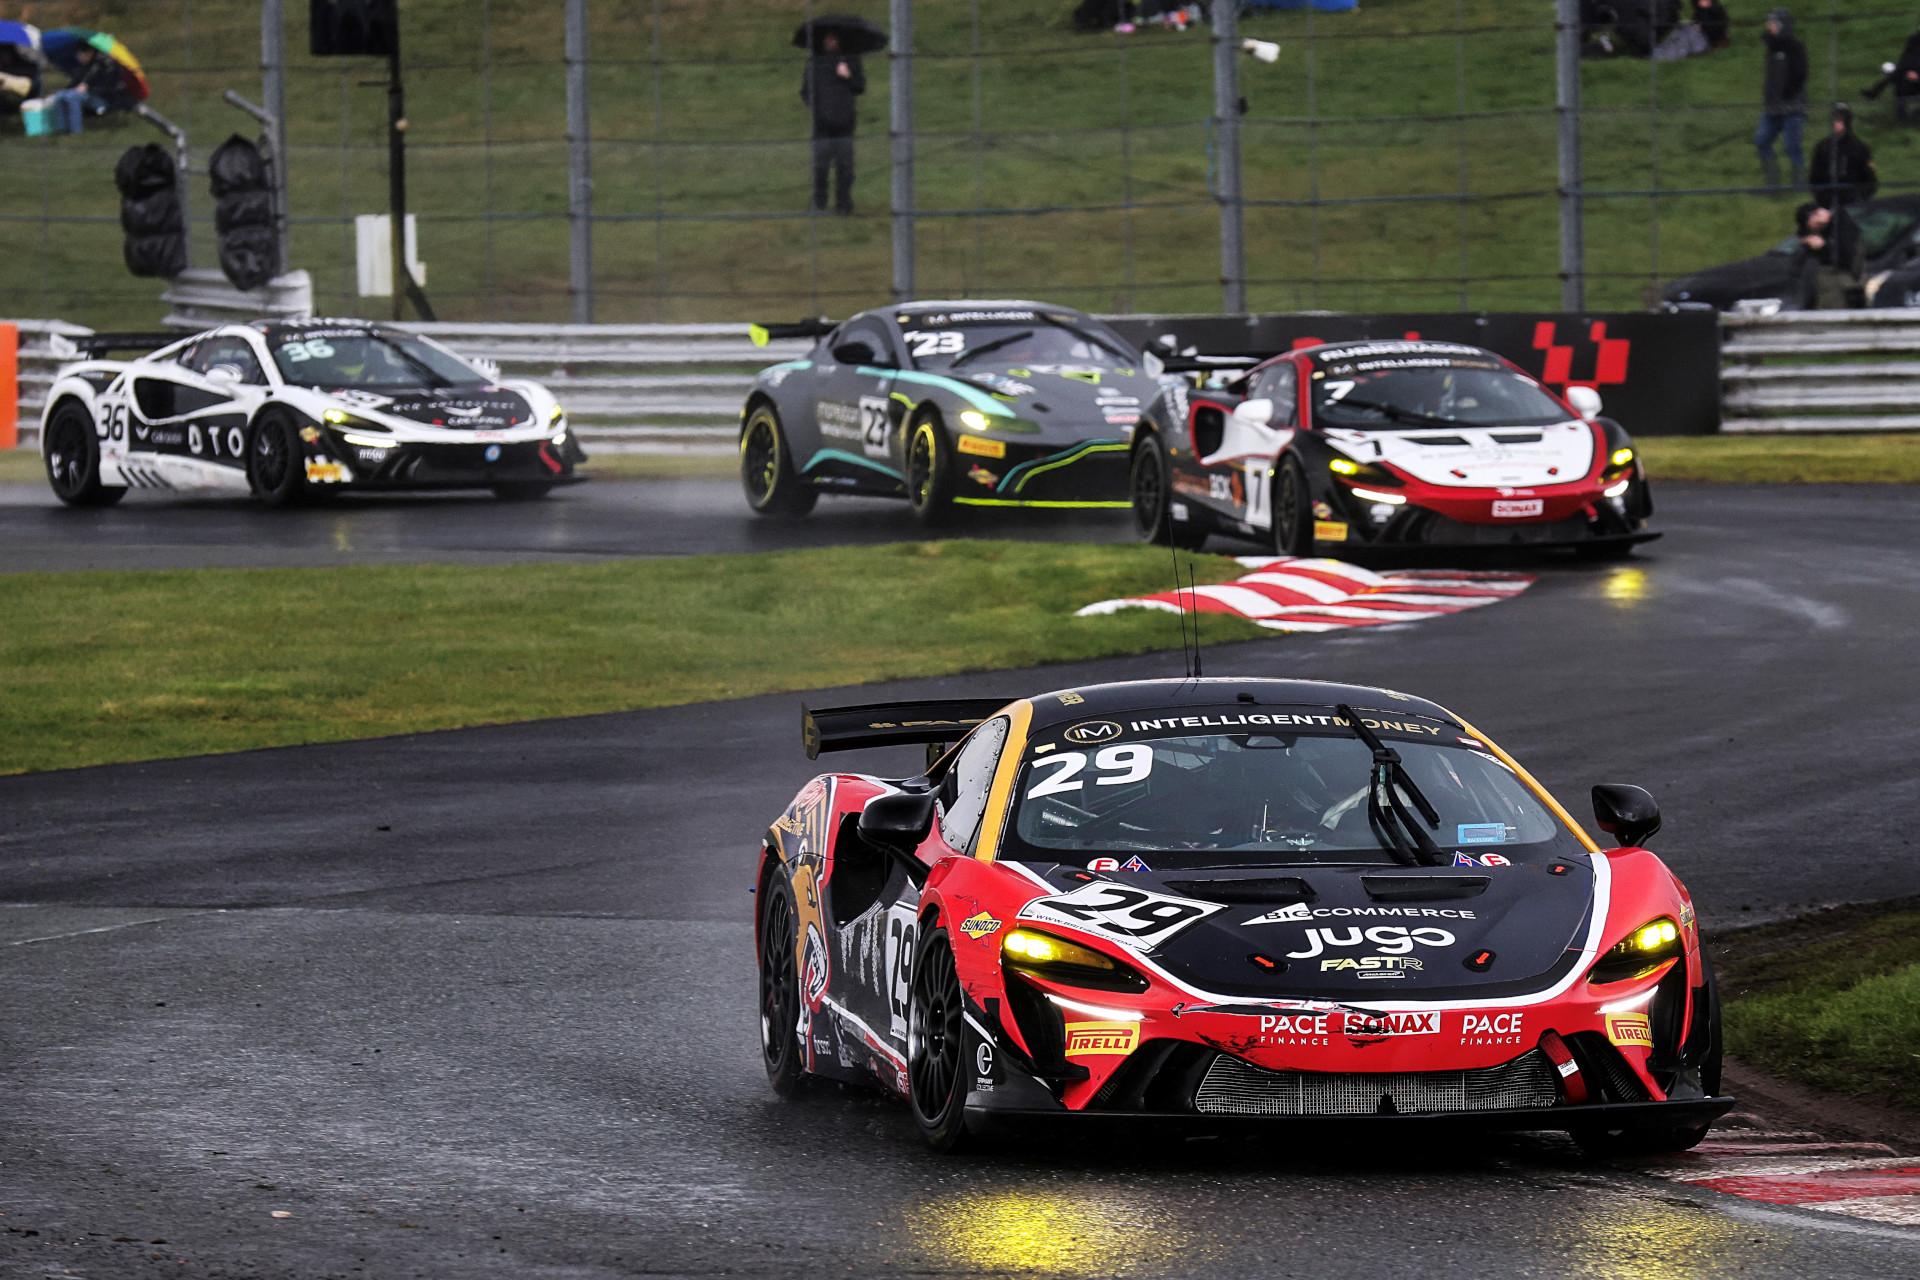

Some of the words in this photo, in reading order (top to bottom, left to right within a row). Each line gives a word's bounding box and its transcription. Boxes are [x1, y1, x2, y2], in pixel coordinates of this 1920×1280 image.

[281, 338, 336, 362] 36
[903, 331, 965, 357] 23
[1324, 380, 1356, 406] 7
[97, 403, 126, 442] 36
[864, 405, 886, 447] 23
[188, 423, 244, 458] DTO
[1253, 470, 1263, 515] 7
[1073, 724, 1112, 739] IM
[1027, 743, 1154, 800] 29
[1037, 887, 1204, 937] 29
[961, 919, 1001, 932] SUNOCO
[891, 917, 915, 1022] 29
[1320, 956, 1425, 972] FASTR
[1261, 1014, 1329, 1035] PACE
[1347, 1013, 1434, 1034] SONAX
[1462, 1012, 1524, 1035] PACE
[1065, 1029, 1134, 1051] PIRELLI
[1260, 1035, 1329, 1046] FINANCE
[1460, 1035, 1521, 1046] FINANCE
